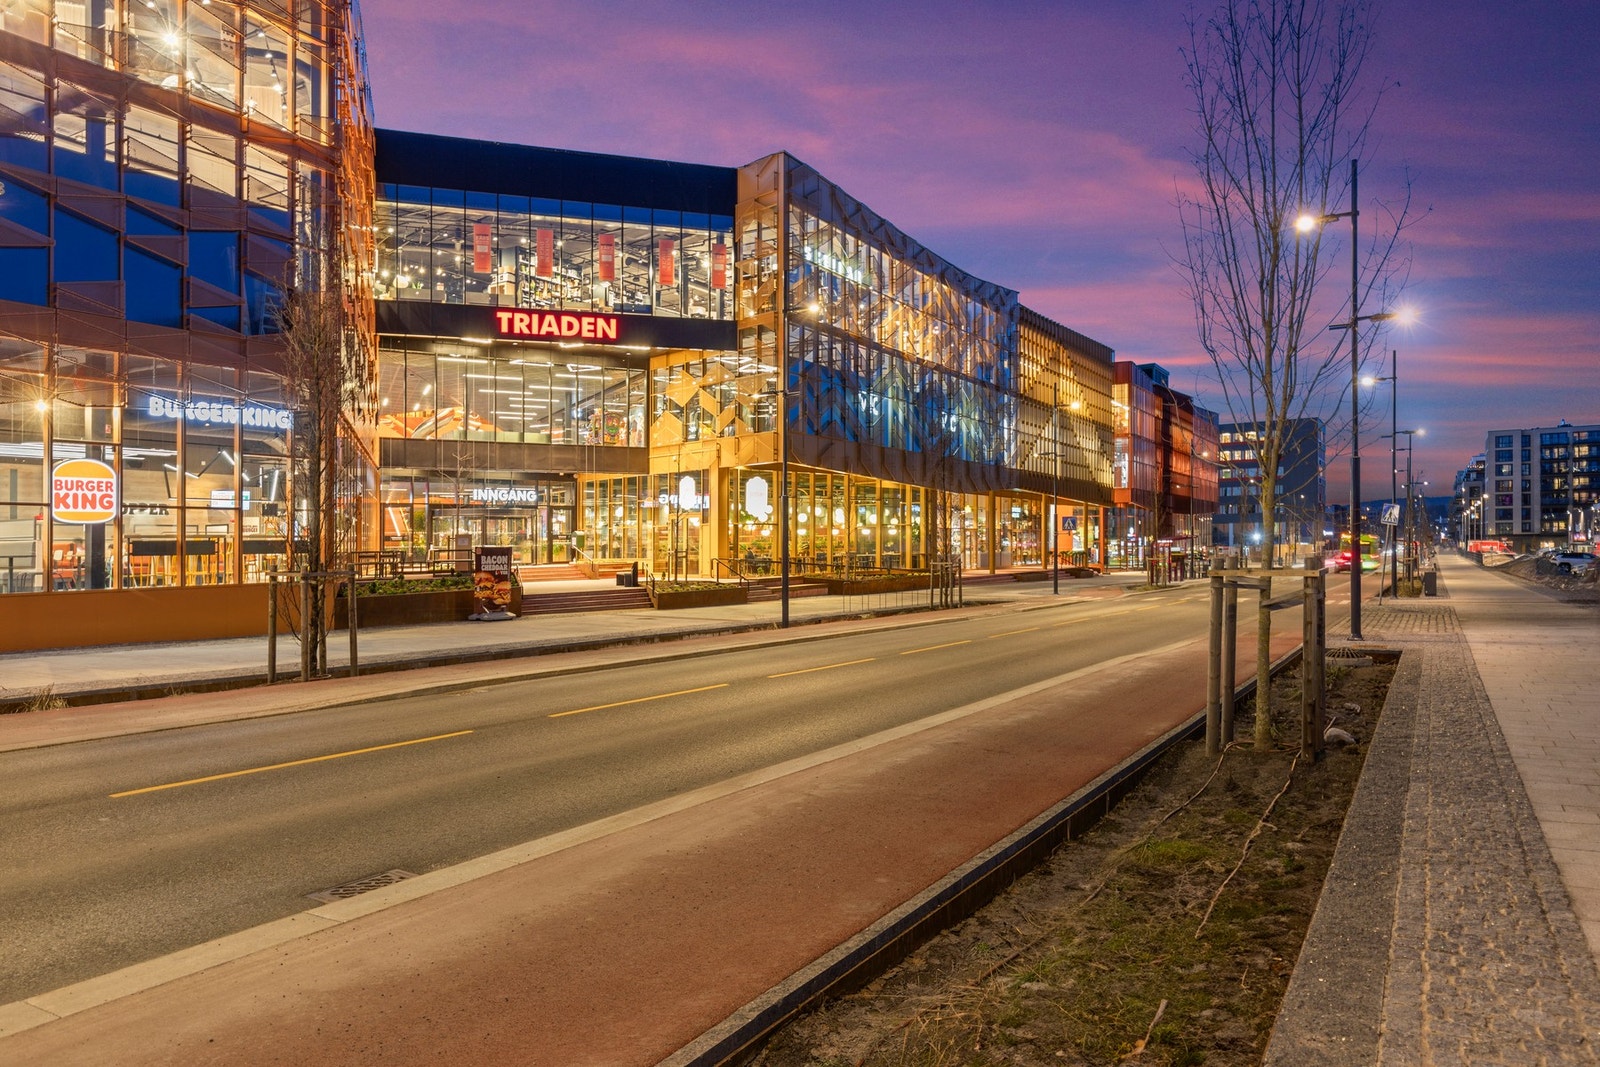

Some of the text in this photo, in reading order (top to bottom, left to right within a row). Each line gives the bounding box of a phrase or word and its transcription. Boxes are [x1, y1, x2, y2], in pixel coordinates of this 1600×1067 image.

[496, 311, 617, 339] TRIADEN
[150, 396, 294, 429] BURGER KING
[53, 479, 114, 492] BURGER
[53, 492, 114, 510] KING
[481, 555, 508, 565] BACON
